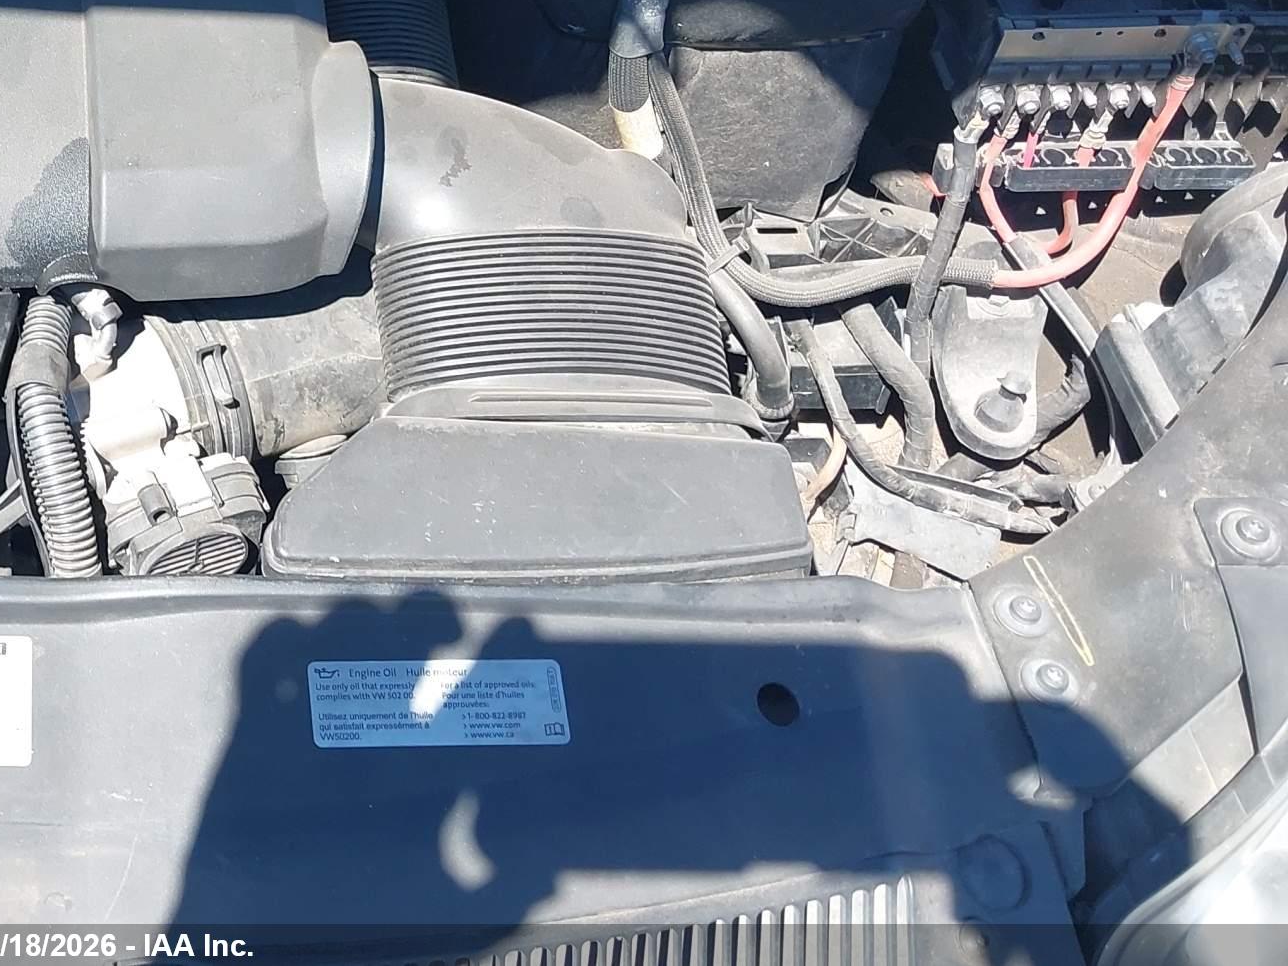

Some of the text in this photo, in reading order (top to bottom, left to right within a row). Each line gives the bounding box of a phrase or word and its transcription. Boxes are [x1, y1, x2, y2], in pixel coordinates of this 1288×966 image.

[349, 667, 397, 679] Engine Oil
[406, 667, 467, 676] Huile mteur
[315, 681, 415, 691] Use only oil that expressly
[461, 680, 472, 689] list
[473, 680, 482, 689] of
[485, 680, 519, 690] approved
[316, 692, 351, 701] complies
[352, 692, 371, 700] with
[372, 691, 385, 700] VW
[387, 691, 401, 700] 502
[442, 691, 459, 699] Pour
[477, 690, 492, 699] liste
[495, 690, 525, 699] d'huiles
[318, 711, 434, 721] Utilisez uniquement de l'huile
[319, 721, 430, 732] qui satisfait expressément à
[469, 722, 521, 730] www.vw.com
[470, 731, 514, 739] www.vw.ca
